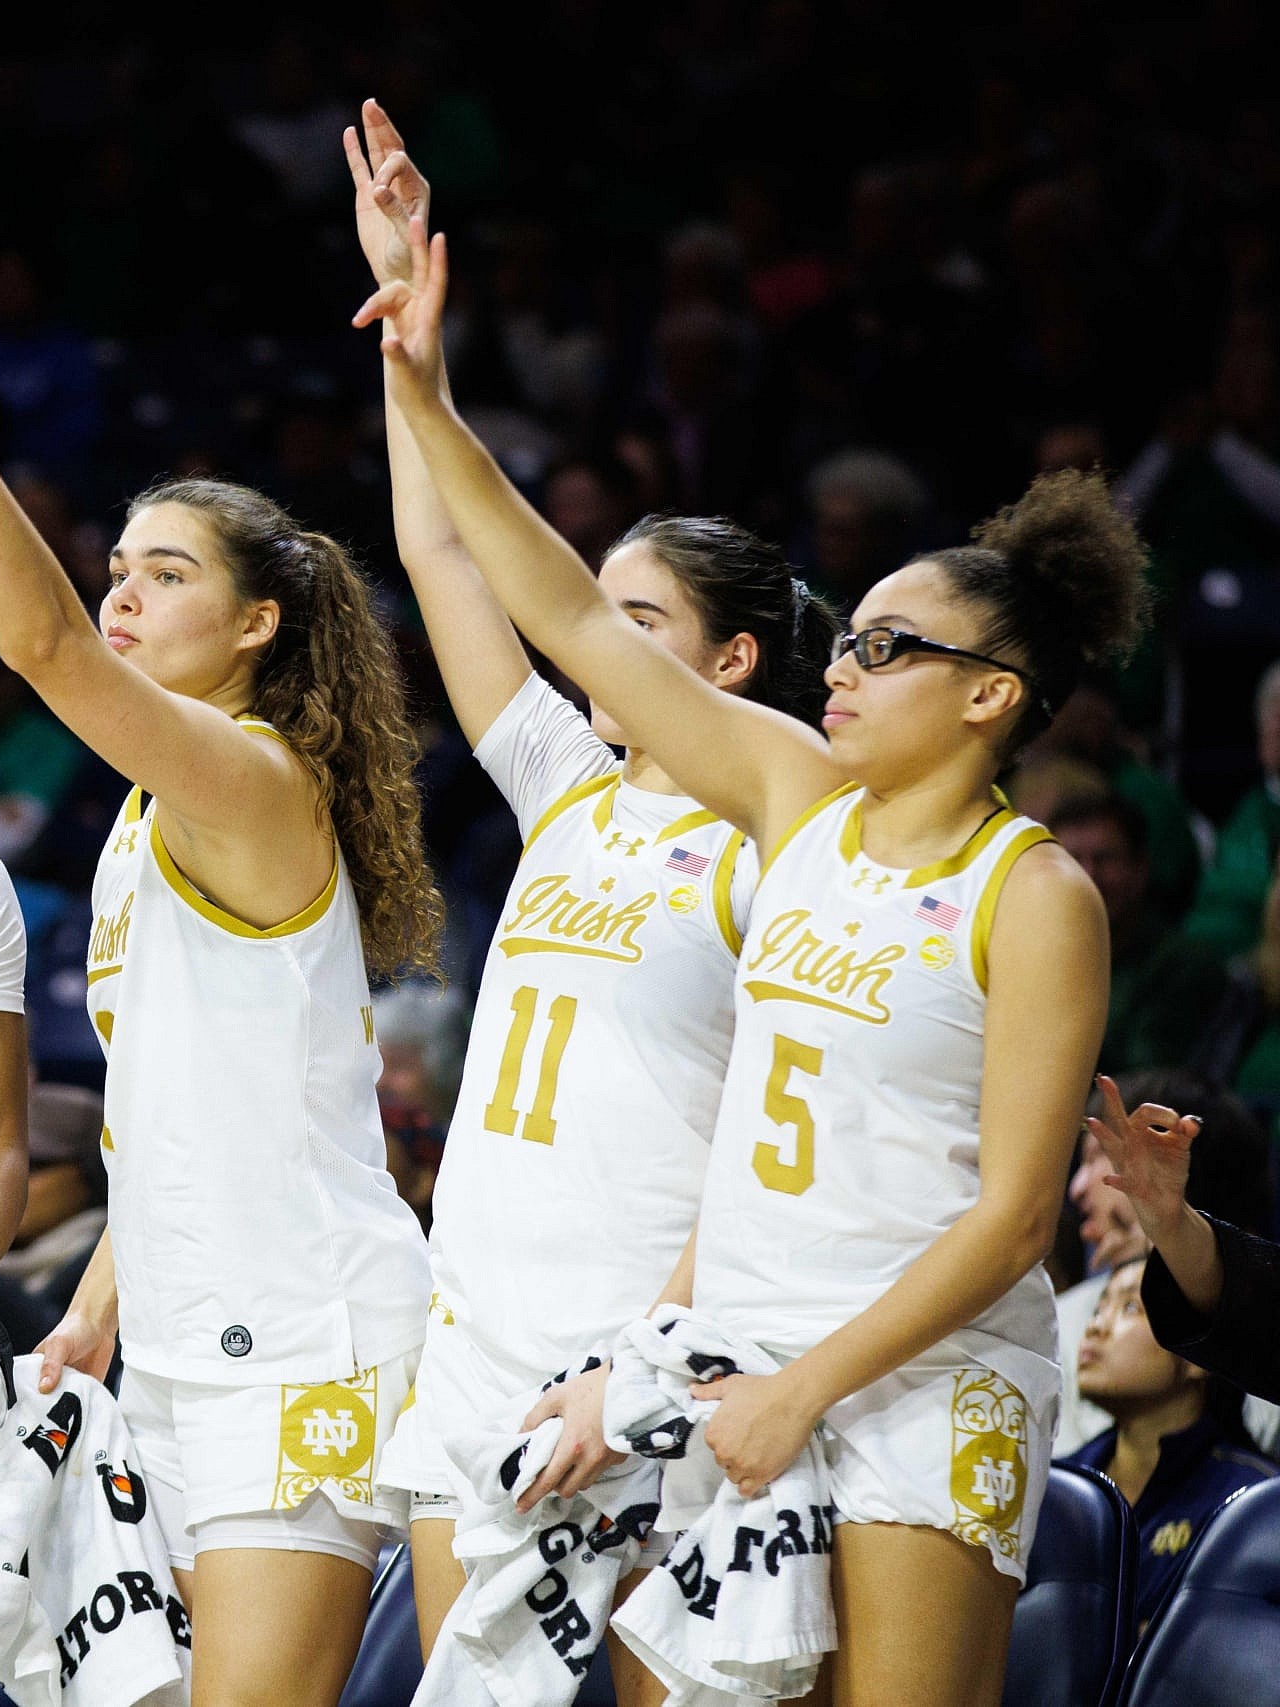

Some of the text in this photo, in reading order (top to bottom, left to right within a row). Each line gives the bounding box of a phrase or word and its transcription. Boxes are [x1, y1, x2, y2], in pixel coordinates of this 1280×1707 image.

[89, 890, 135, 964] rish
[503, 874, 657, 946] Irish
[746, 909, 906, 995] Irish
[483, 984, 578, 1147] 11
[751, 1033, 824, 1197] 5
